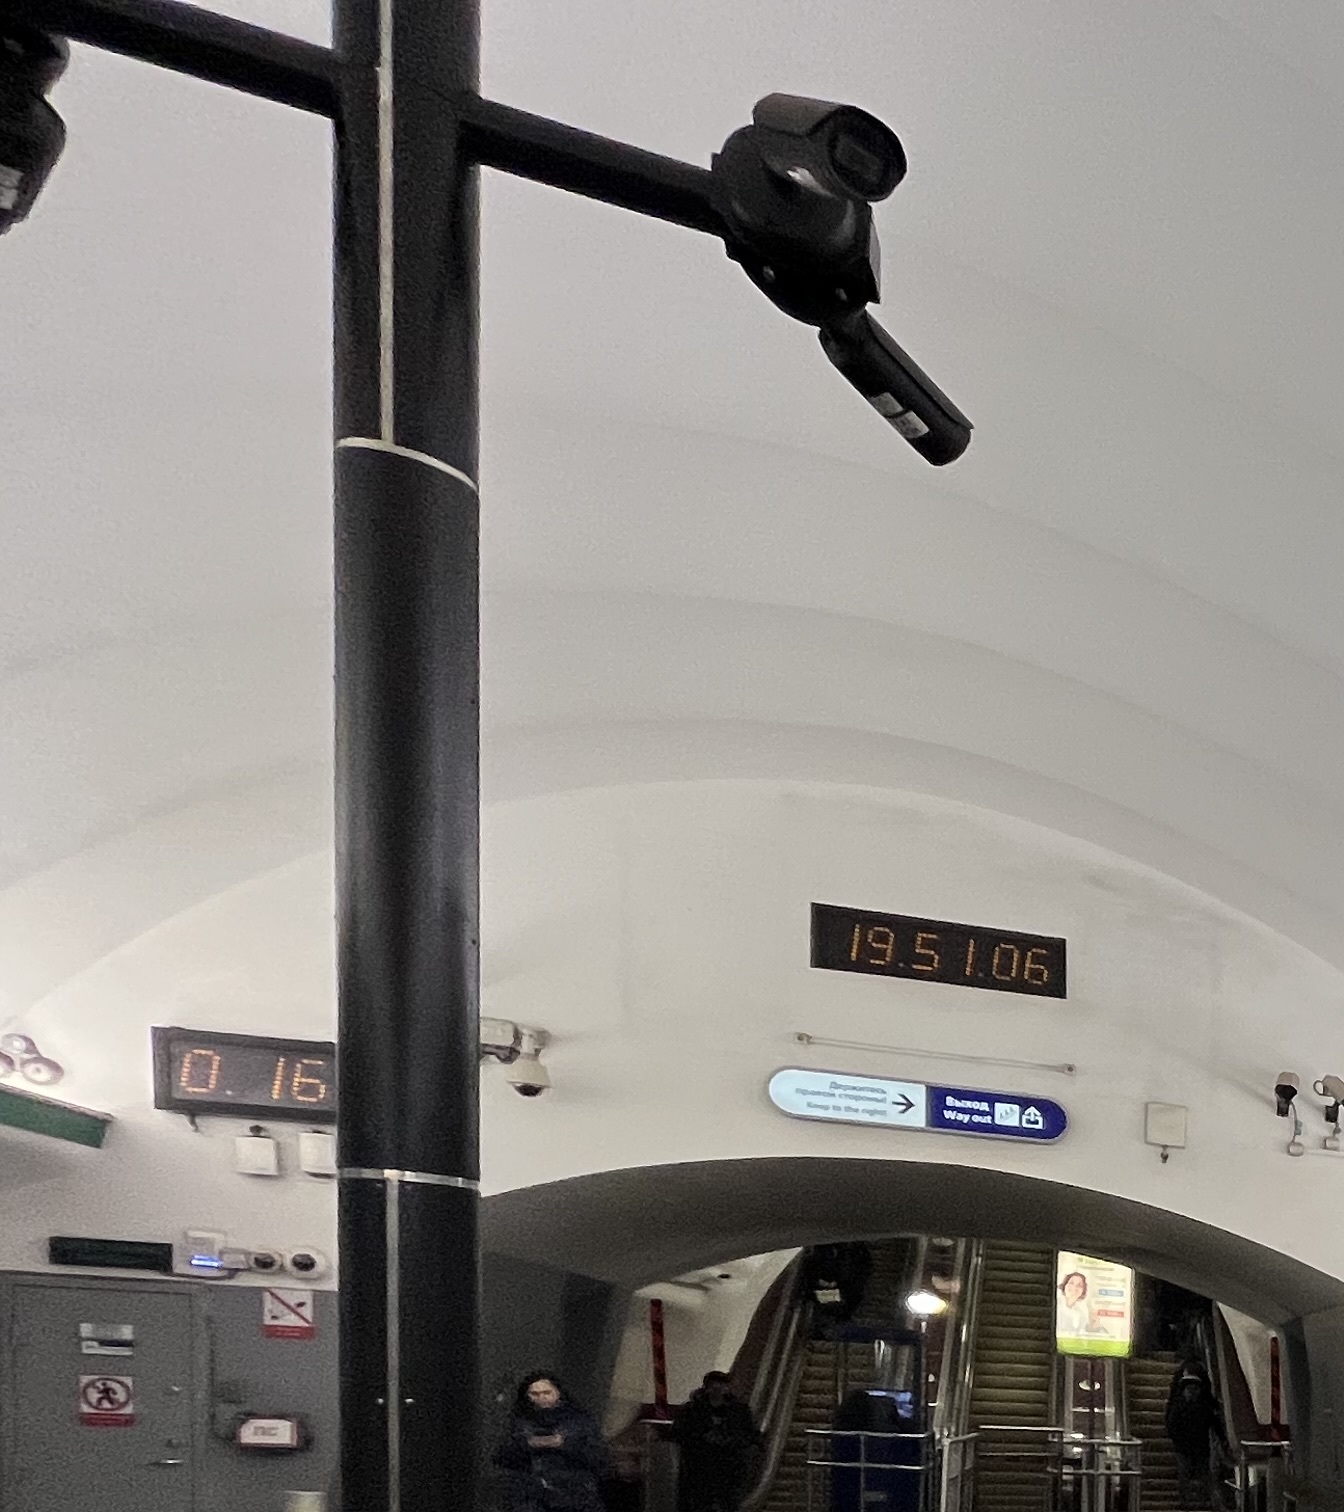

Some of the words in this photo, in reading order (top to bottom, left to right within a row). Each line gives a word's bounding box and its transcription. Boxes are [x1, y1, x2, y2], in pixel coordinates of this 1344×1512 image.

[945, 1095, 990, 1112] Выход
[943, 1110, 970, 1124] Way
[971, 1114, 992, 1125] out
